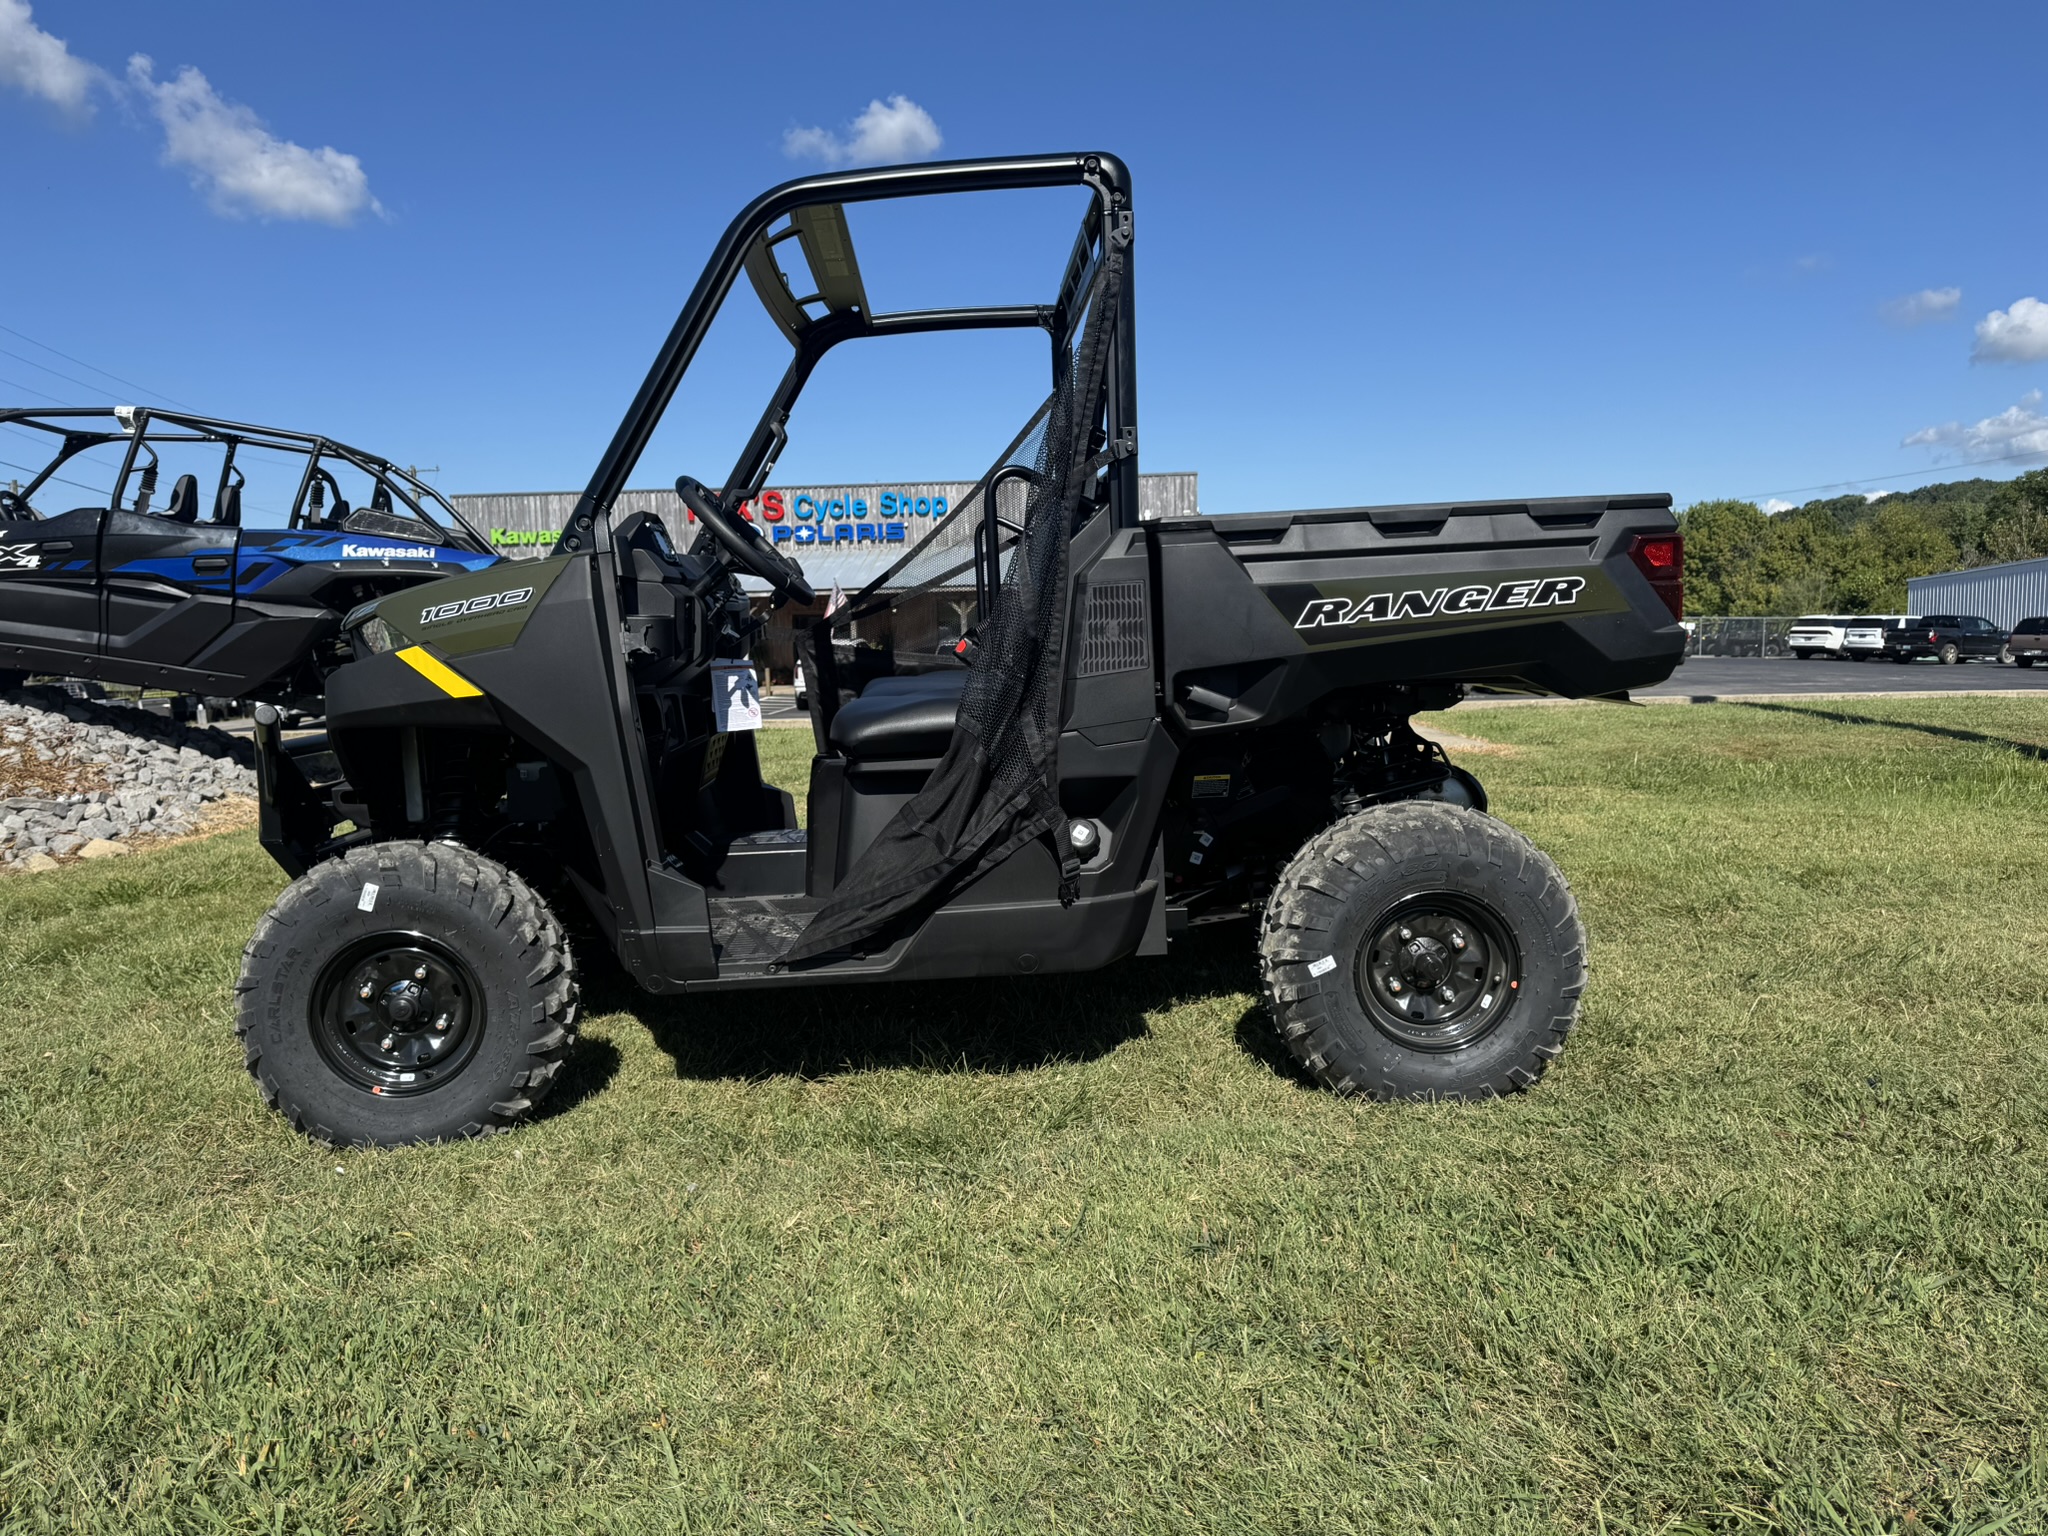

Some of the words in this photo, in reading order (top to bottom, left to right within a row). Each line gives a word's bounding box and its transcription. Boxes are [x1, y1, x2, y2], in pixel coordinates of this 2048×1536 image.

[794, 494, 867, 522] Cycle
[880, 492, 948, 520] Shop
[773, 522, 905, 543] POLARIS
[342, 544, 435, 558] Kawasaki
[420, 587, 533, 624] 1000
[1294, 576, 1586, 628] RANGER
[421, 620, 455, 631] SINGLE
[456, 610, 506, 624] OVERHEAD
